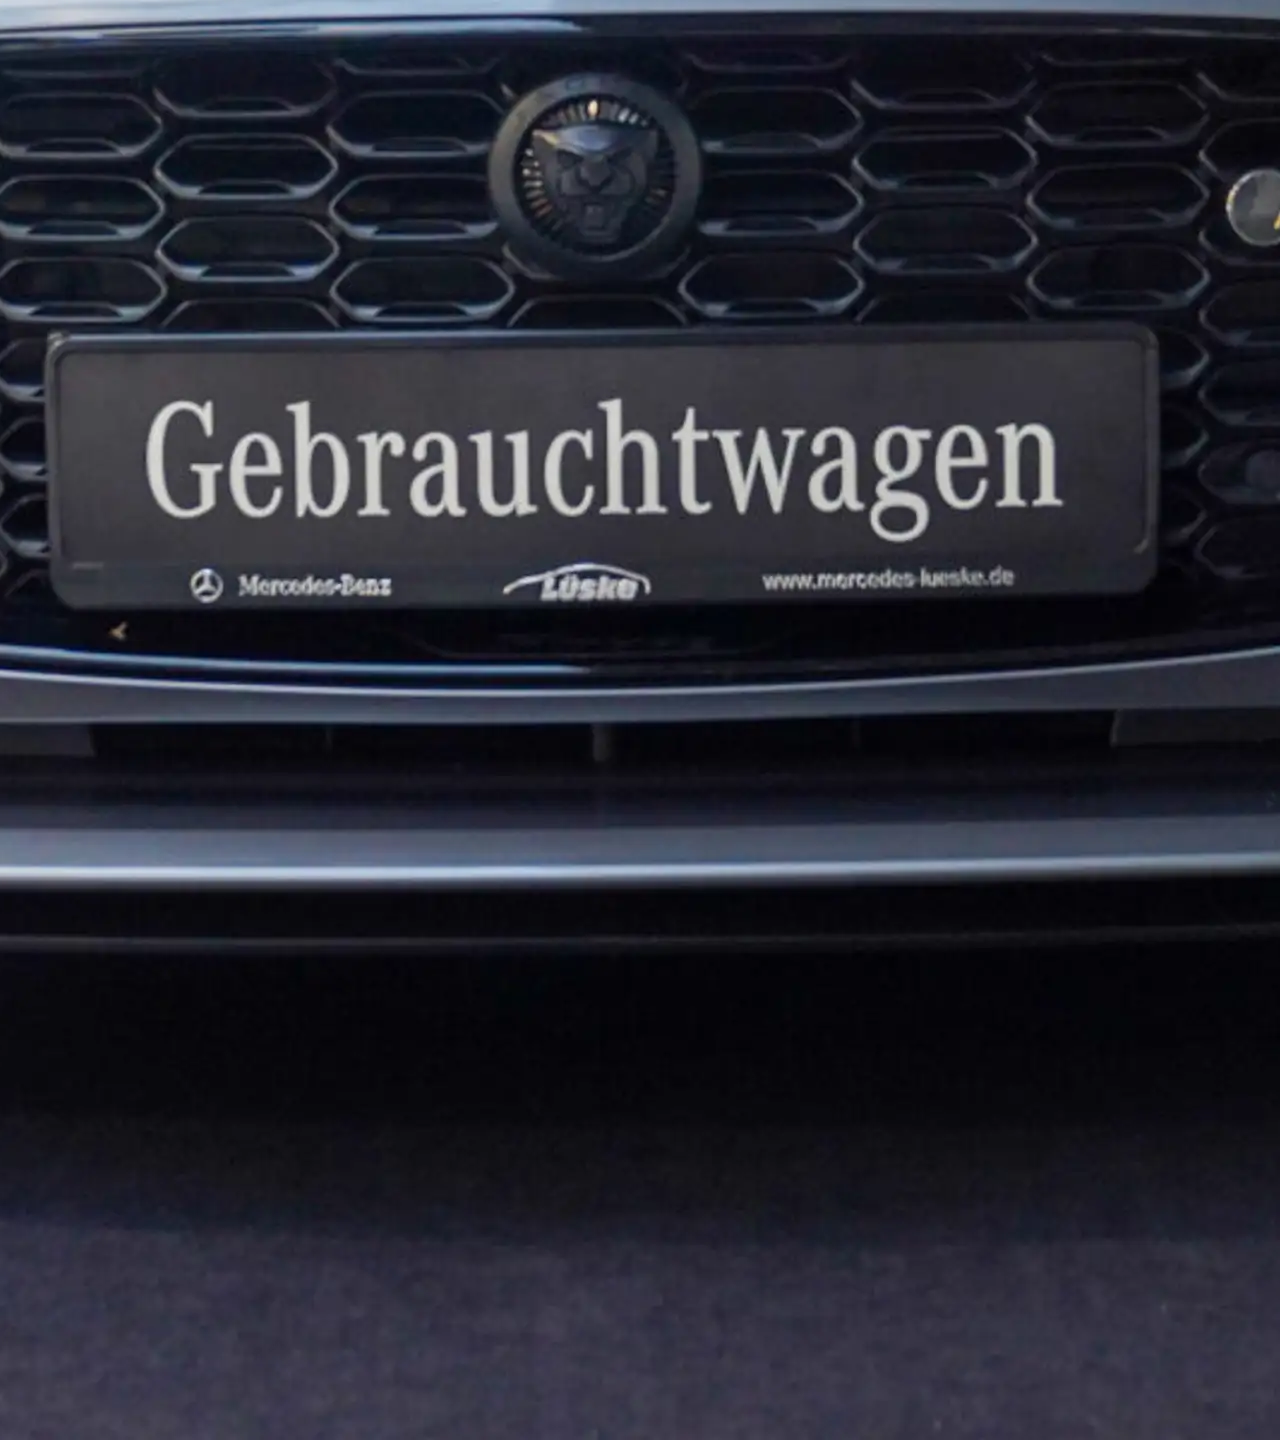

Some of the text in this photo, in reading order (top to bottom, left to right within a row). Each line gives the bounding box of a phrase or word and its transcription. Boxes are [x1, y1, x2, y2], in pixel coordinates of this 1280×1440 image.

[147, 399, 1062, 541] Gebrauchtwagen
[239, 574, 392, 596] Mercedes-Benz
[762, 566, 1014, 590] www.mercedes-lueske.de
